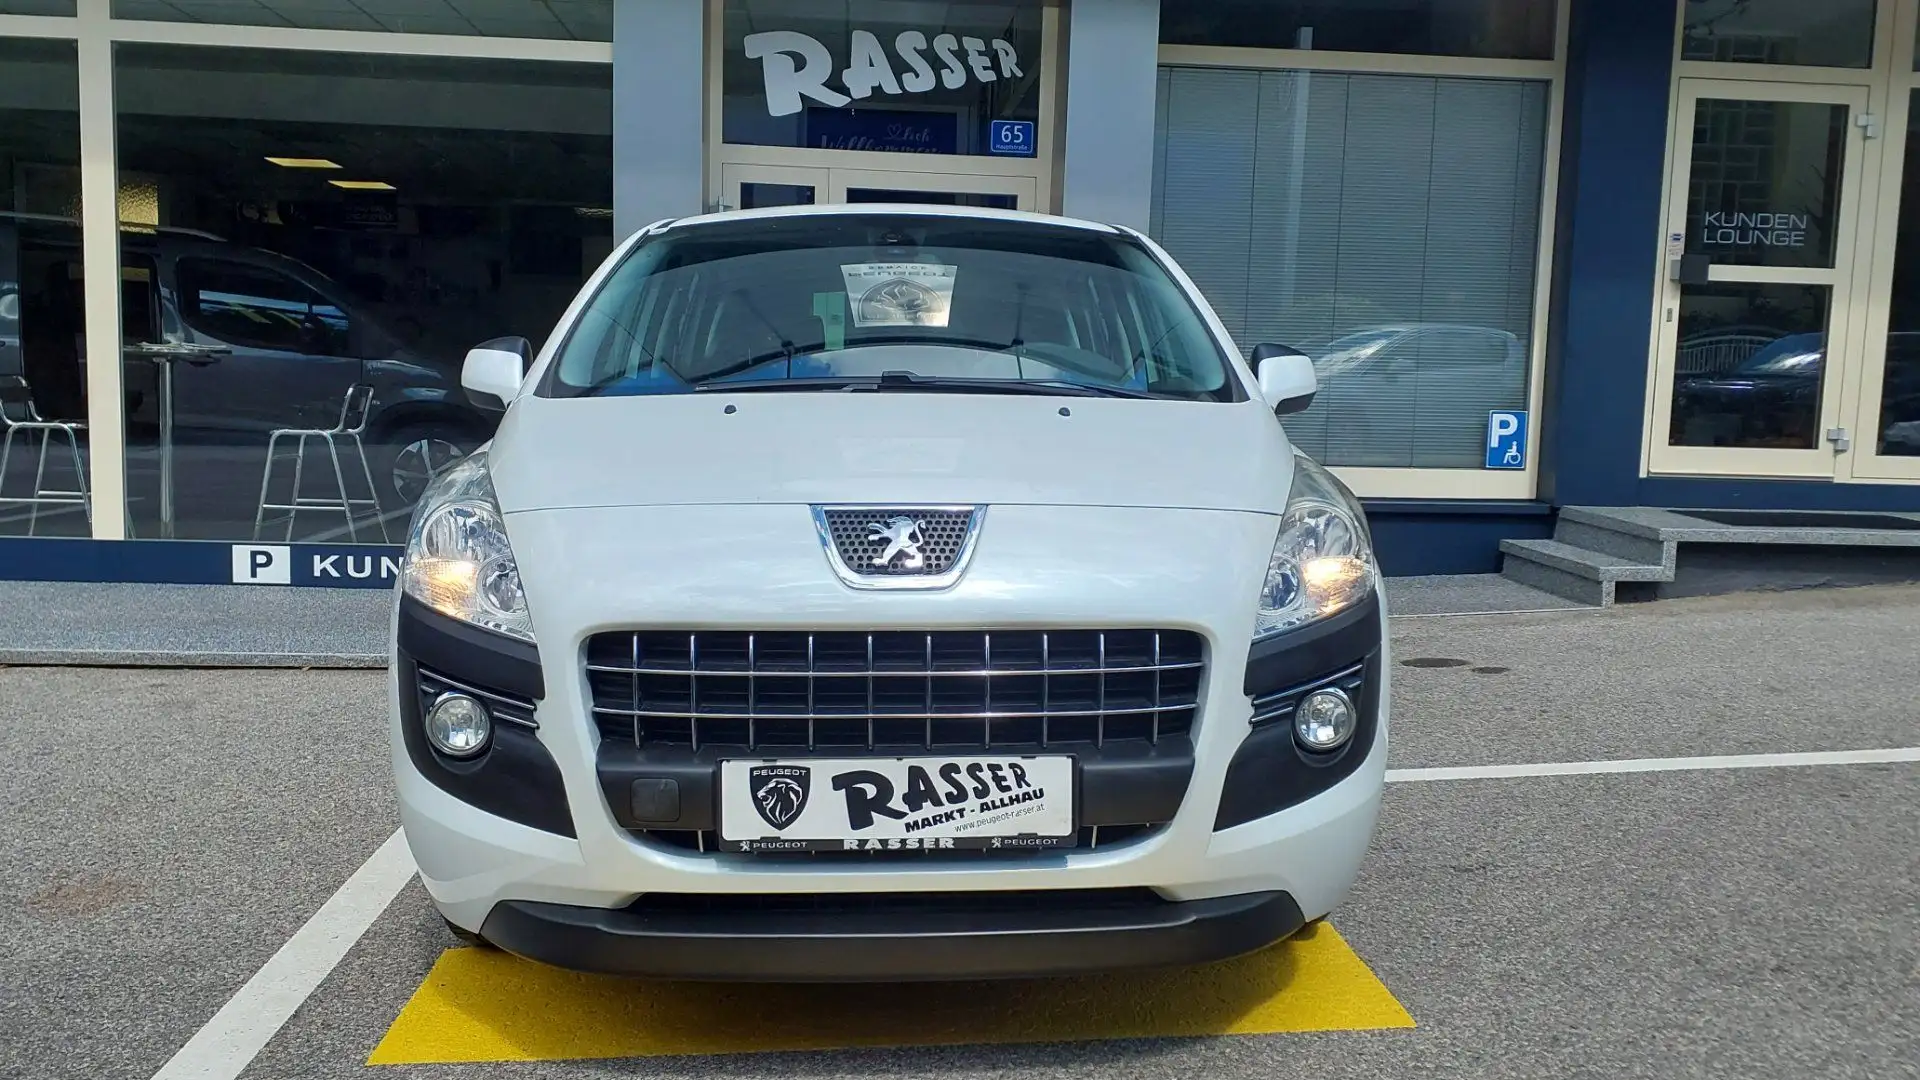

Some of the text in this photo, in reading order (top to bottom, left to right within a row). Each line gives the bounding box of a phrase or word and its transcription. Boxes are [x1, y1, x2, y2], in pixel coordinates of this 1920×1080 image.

[744, 30, 1023, 116] RASSER
[1001, 125, 1023, 143] 65
[1705, 211, 1807, 229] KUNDEN
[1703, 228, 1805, 246] LOUNGE
[1490, 413, 1519, 448] P
[250, 550, 273, 579] P
[753, 768, 807, 777] PEUGEOT
[831, 762, 1031, 831] RASSER
[904, 807, 966, 833] MARKT
[979, 788, 1045, 813] ALLHAU
[954, 803, 1045, 833] www.peugeot-rasser.at
[753, 841, 808, 849] PEUGEOT
[843, 838, 955, 850] RASSER
[1004, 838, 1058, 846] PEUGEOT
